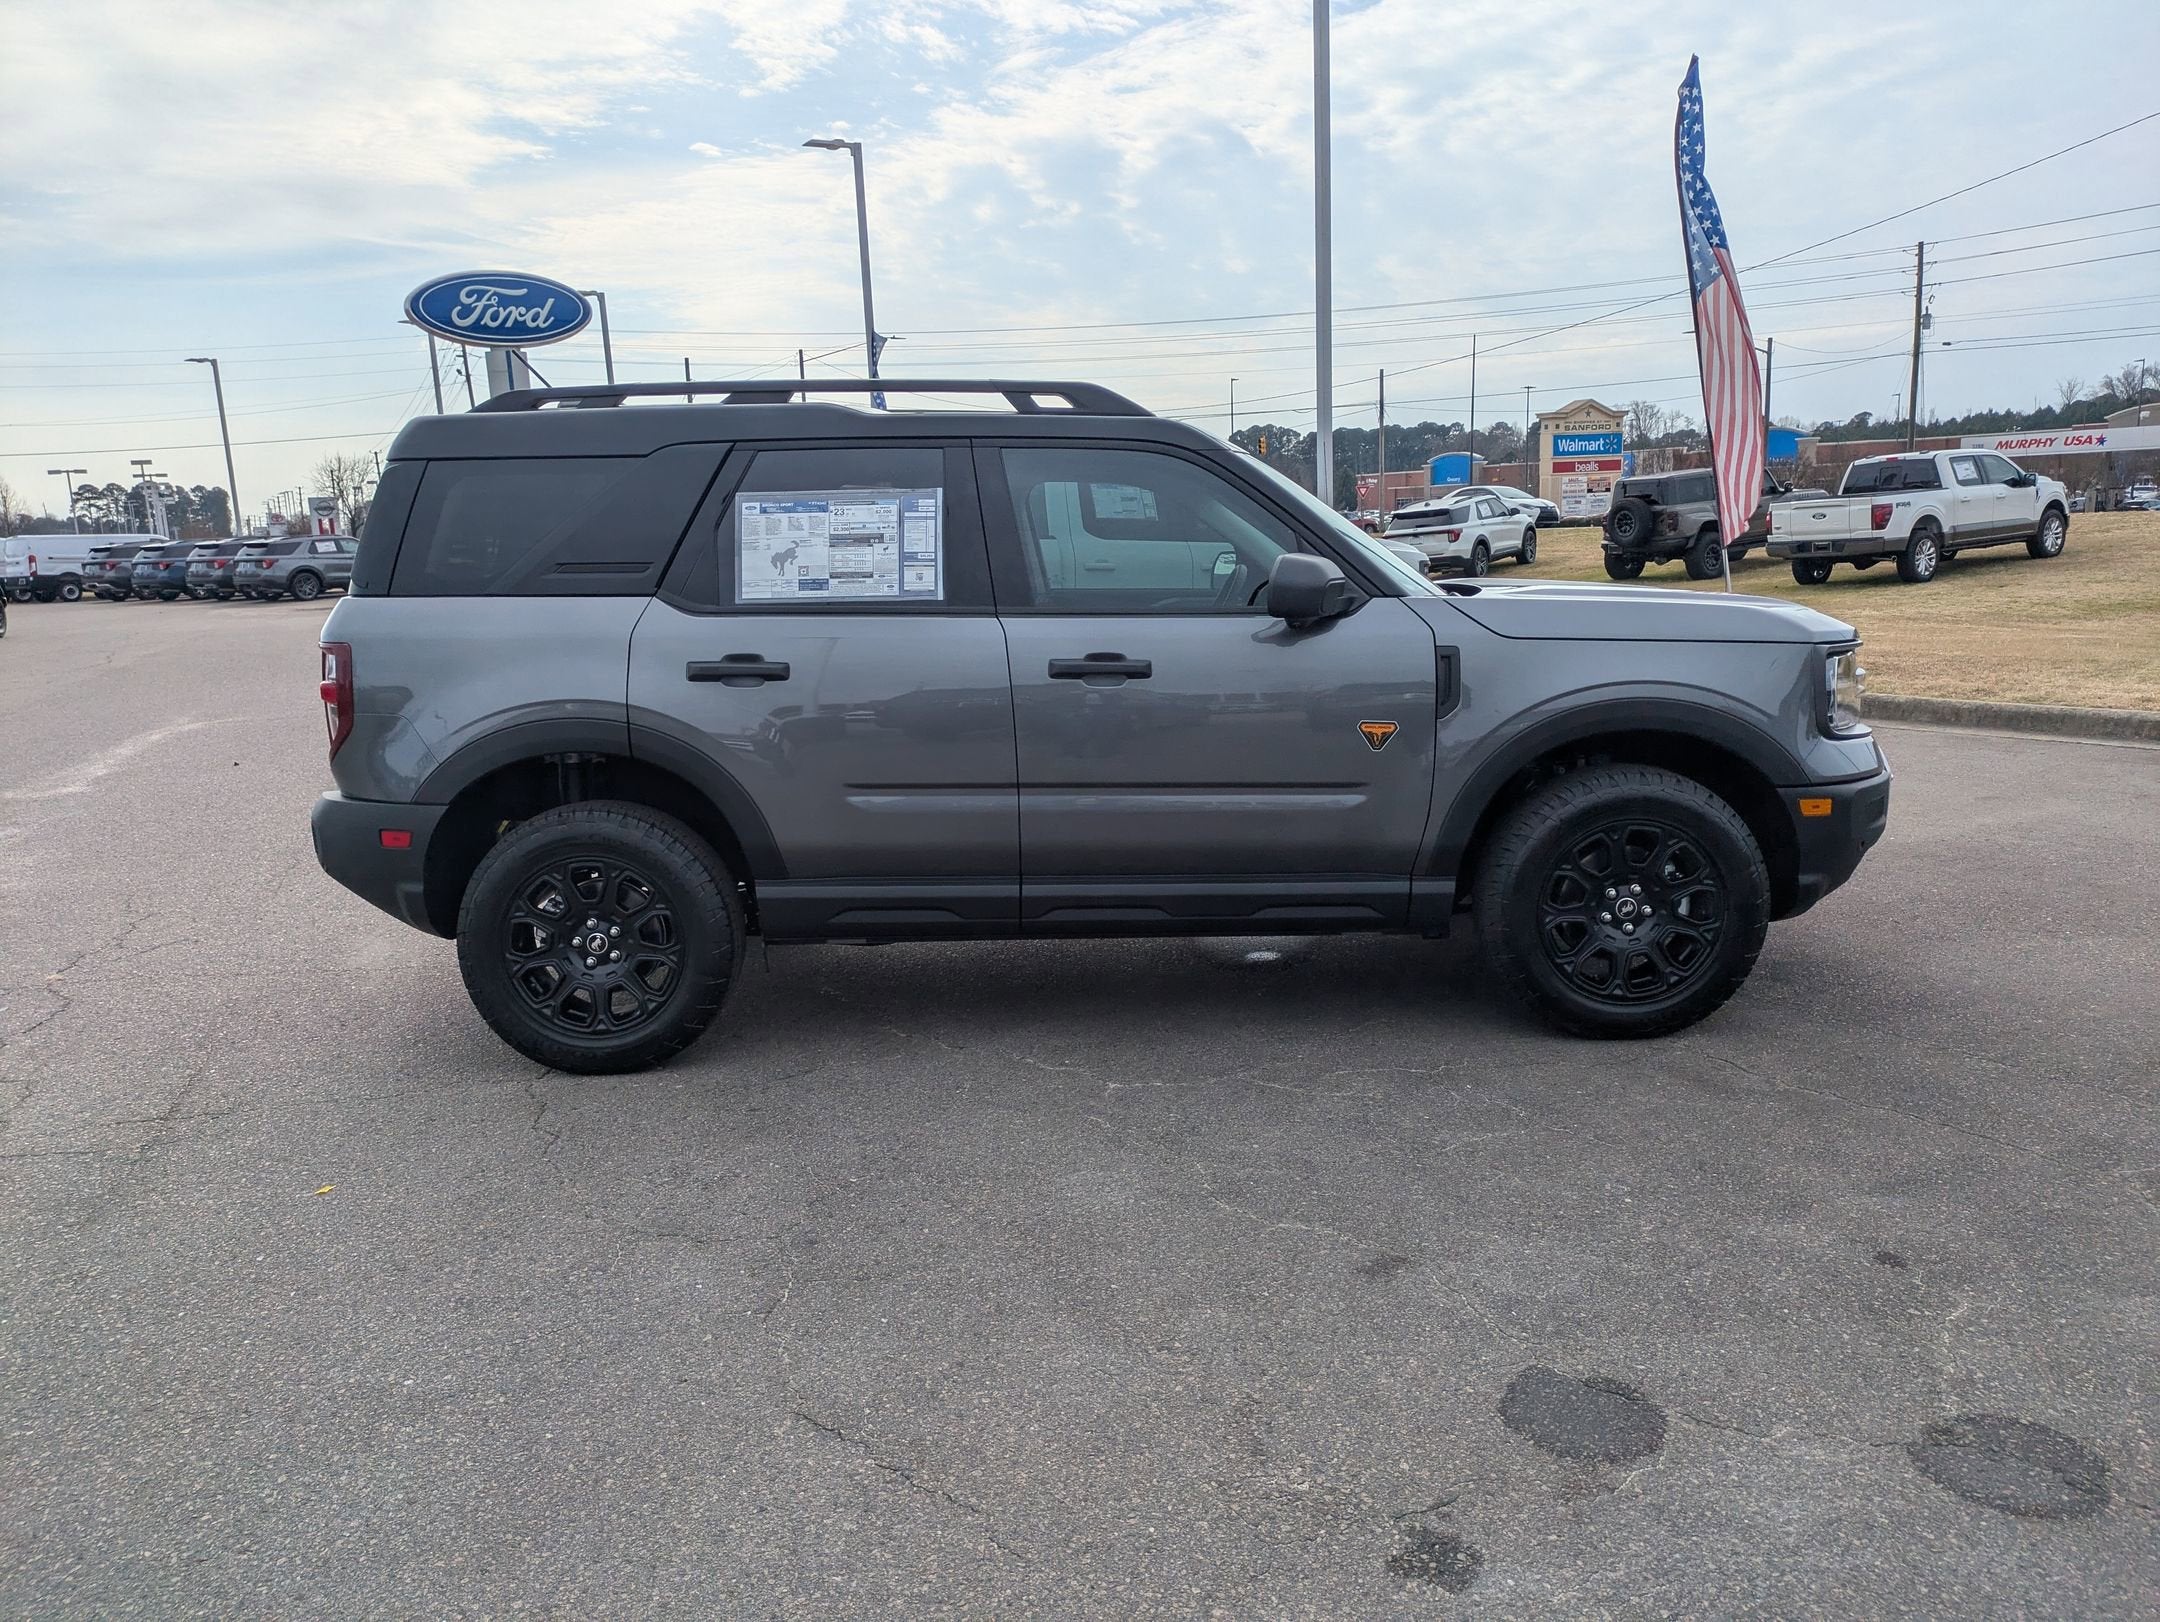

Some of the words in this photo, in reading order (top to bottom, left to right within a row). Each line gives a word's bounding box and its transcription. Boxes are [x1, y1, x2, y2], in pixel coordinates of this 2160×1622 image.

[451, 285, 554, 328] Ford
[1564, 423, 1612, 431] SANFORD
[1557, 437, 1604, 452] Walmart
[1994, 437, 2059, 450] MURPHY
[2063, 435, 2093, 446] USA
[1575, 461, 1599, 472] bealls
[833, 508, 845, 516] 23
